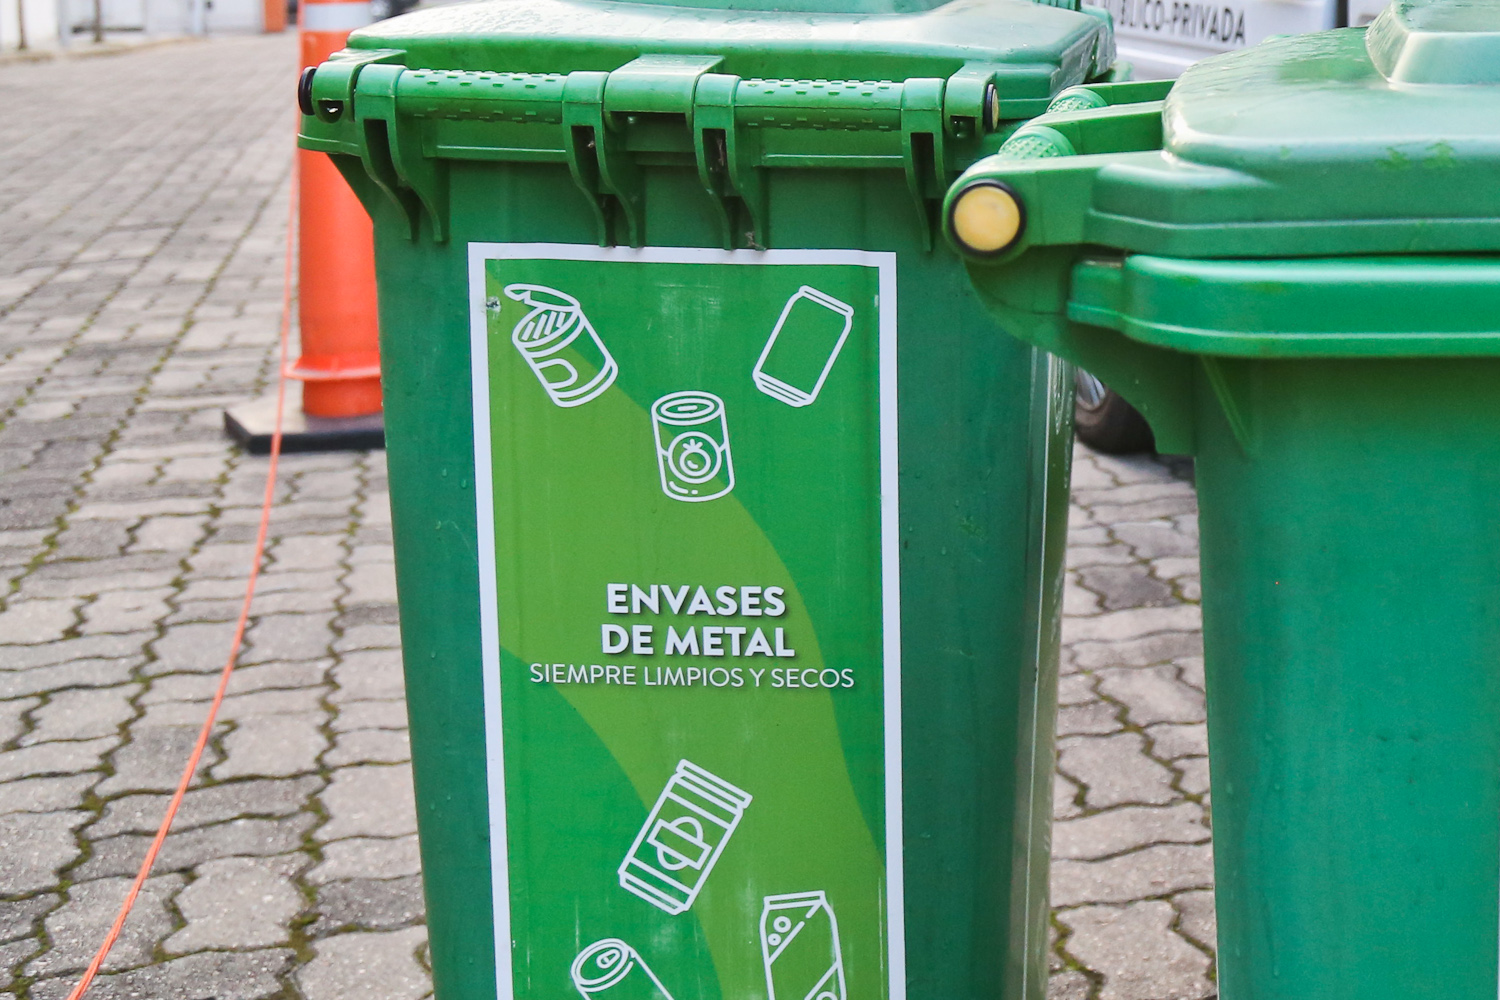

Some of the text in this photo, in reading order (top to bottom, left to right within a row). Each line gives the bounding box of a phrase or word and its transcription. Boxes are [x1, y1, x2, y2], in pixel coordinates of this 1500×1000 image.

[606, 583, 787, 617] ENVASES
[601, 623, 796, 658] DE METAL
[529, 663, 855, 689] SIEMPRE LIMPIOS Y SECOS
